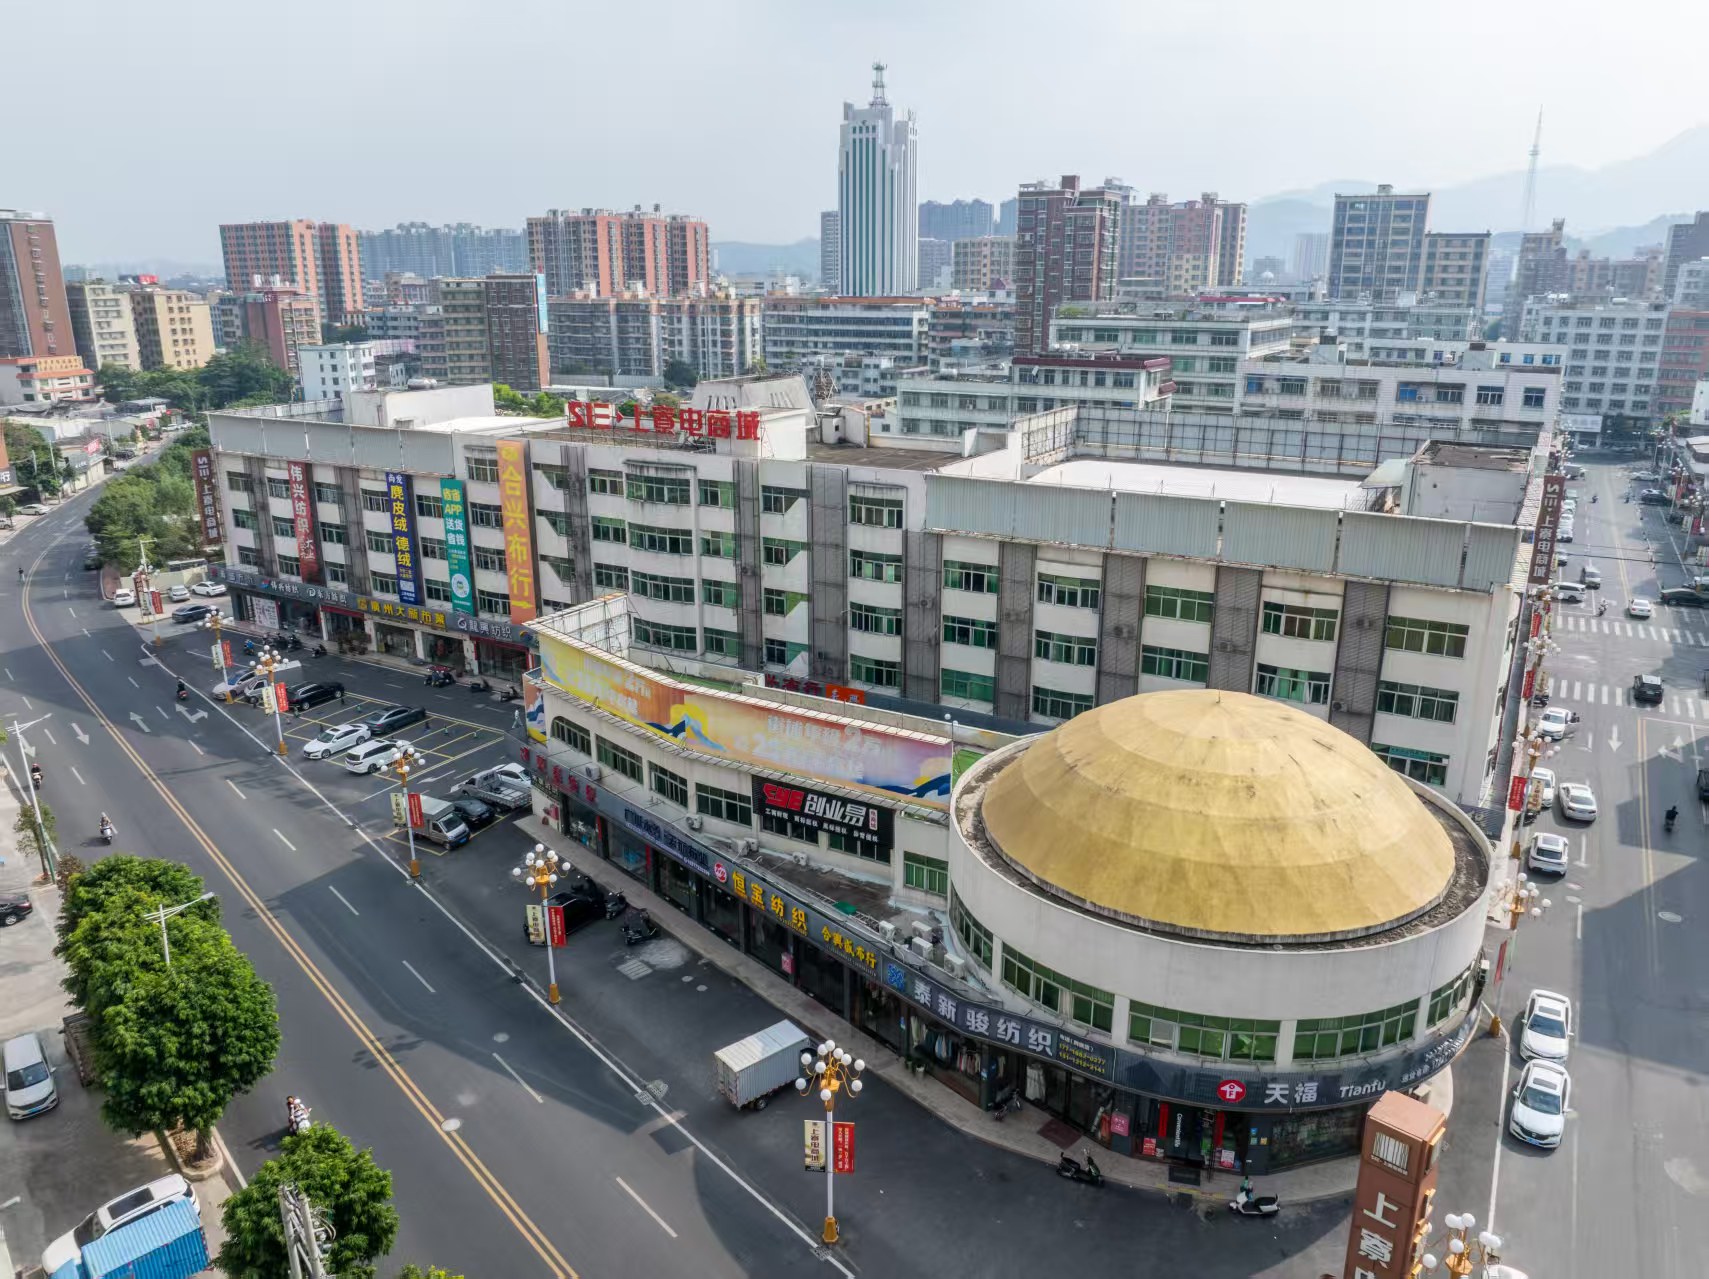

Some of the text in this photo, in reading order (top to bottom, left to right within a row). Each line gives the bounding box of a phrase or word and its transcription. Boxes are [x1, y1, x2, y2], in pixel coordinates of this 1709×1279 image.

[444, 504, 463, 516] APP
[502, 464, 533, 597] 合兴布行
[804, 792, 867, 828] 创业易
[732, 870, 808, 931] 恒宝纺织
[1263, 1079, 1386, 1104] 天福 Tianfu
